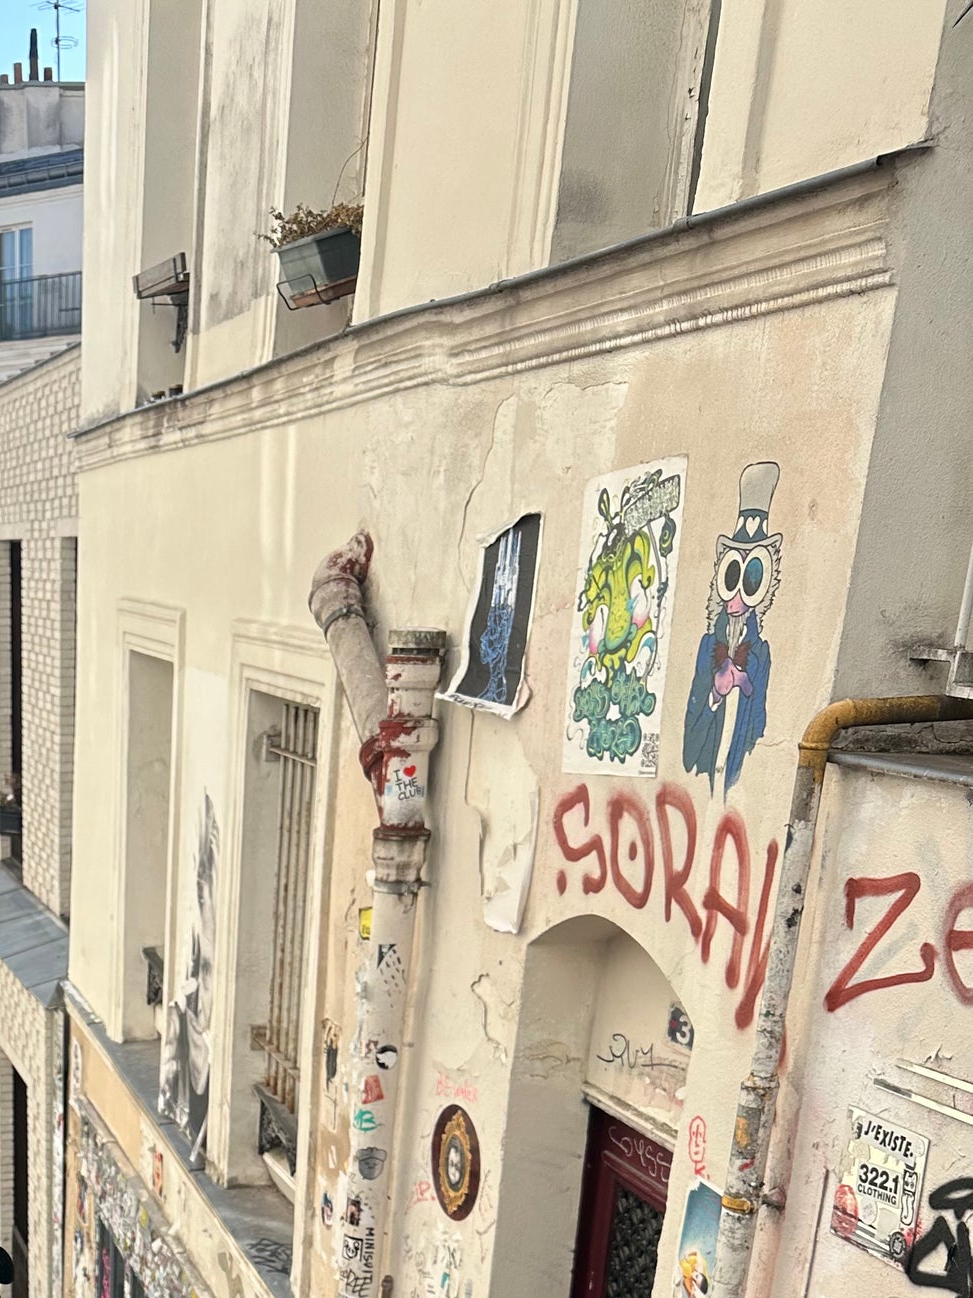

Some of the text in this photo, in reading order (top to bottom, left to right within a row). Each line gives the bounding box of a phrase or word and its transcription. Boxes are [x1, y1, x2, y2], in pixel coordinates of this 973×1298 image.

[395, 777, 418, 791] THE
[858, 1163, 900, 1195] 322.1
[857, 1183, 897, 1206] CLOTHING
